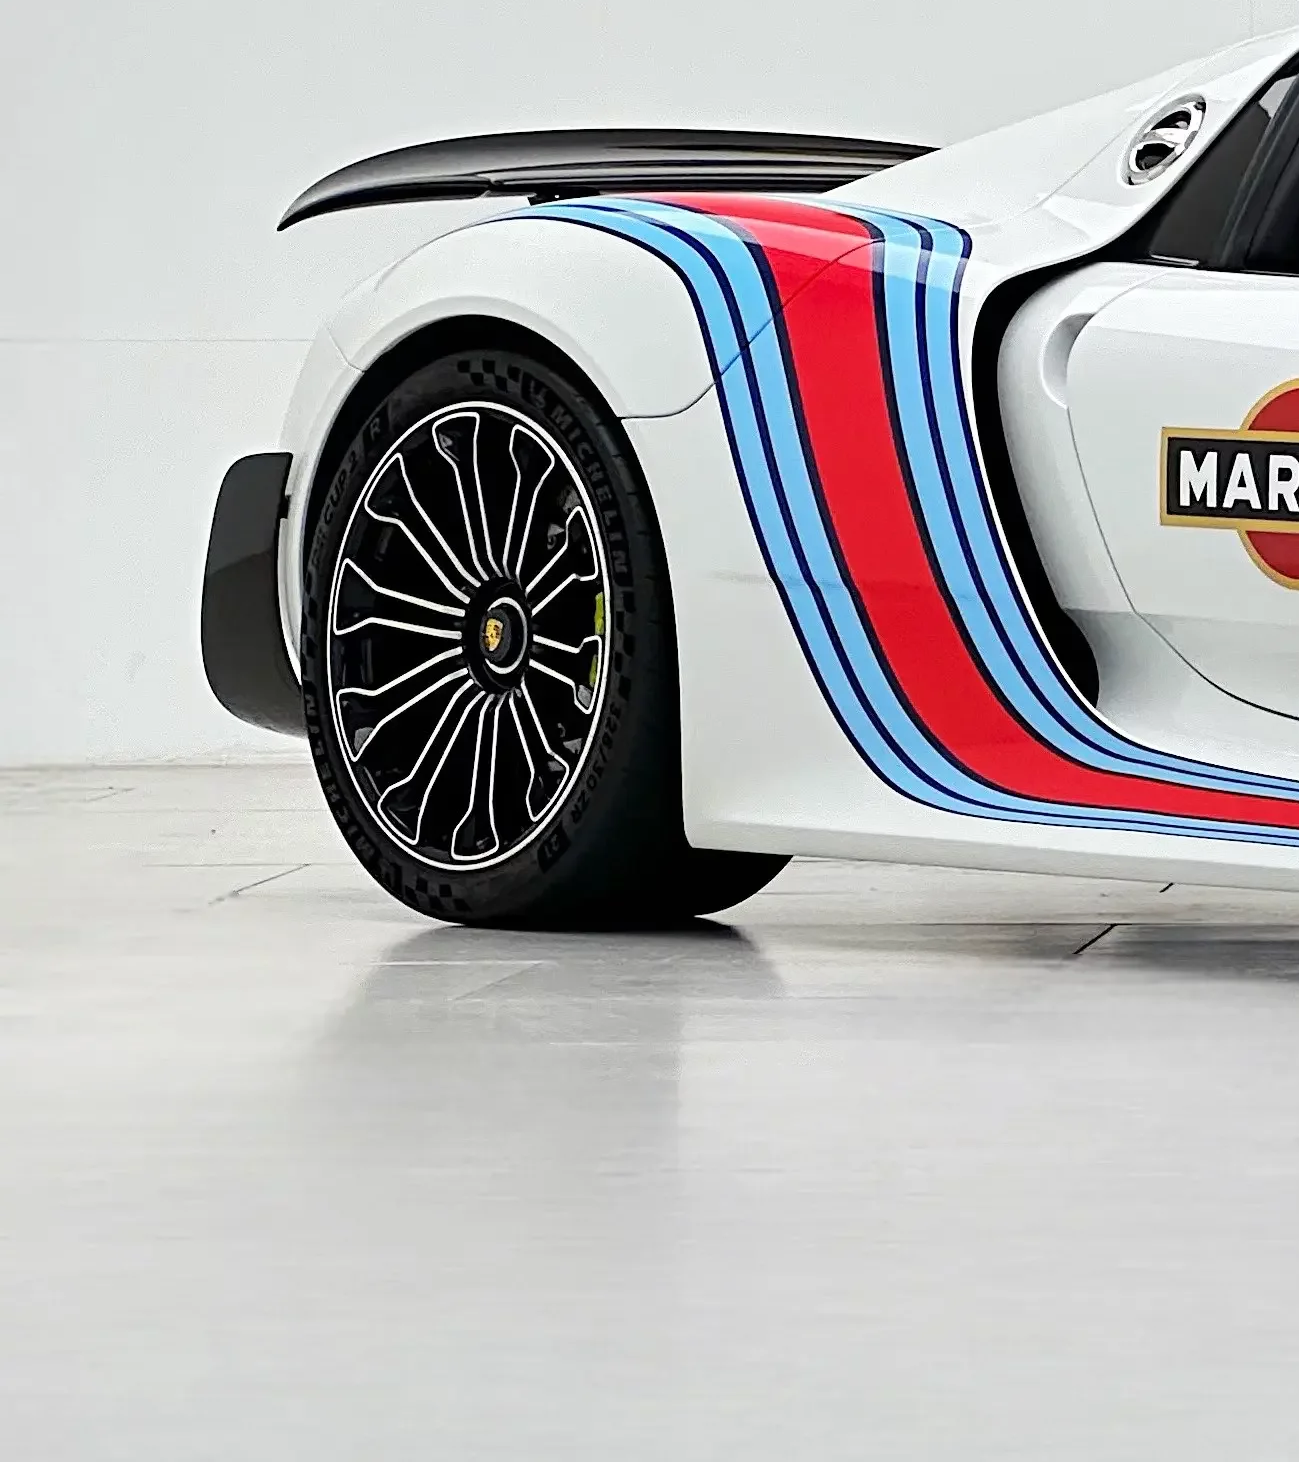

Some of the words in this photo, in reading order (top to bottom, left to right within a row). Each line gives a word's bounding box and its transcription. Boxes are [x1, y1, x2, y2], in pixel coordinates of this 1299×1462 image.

[369, 416, 381, 442] R
[323, 469, 347, 525] CUP
[549, 403, 629, 574] MICHELIN
